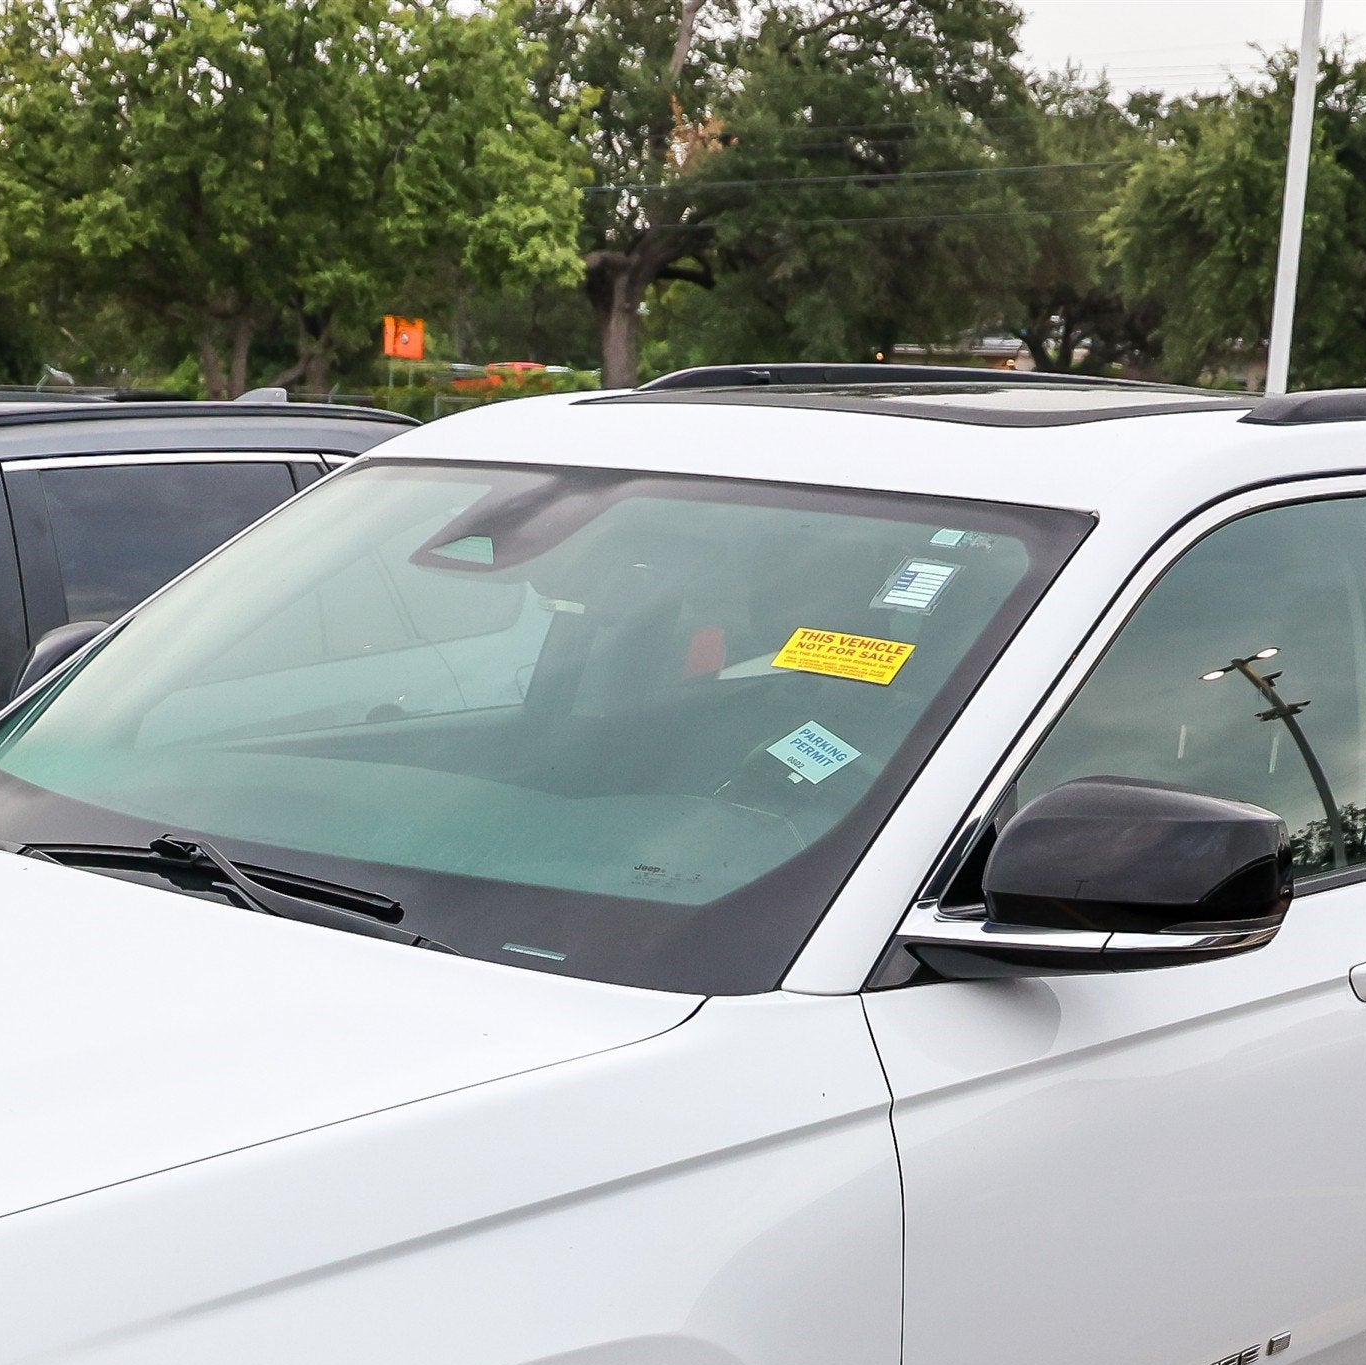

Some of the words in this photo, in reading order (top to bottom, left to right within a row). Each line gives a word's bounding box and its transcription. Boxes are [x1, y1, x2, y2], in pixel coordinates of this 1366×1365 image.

[795, 641, 826, 652] NOT
[827, 646, 856, 657] FOR
[859, 651, 899, 663] SALE
[799, 631, 835, 644] THIS
[839, 636, 908, 656] VEHICLE
[789, 738, 835, 767] PERMIT
[798, 728, 848, 762] PARKING
[634, 863, 661, 873] Jeep
